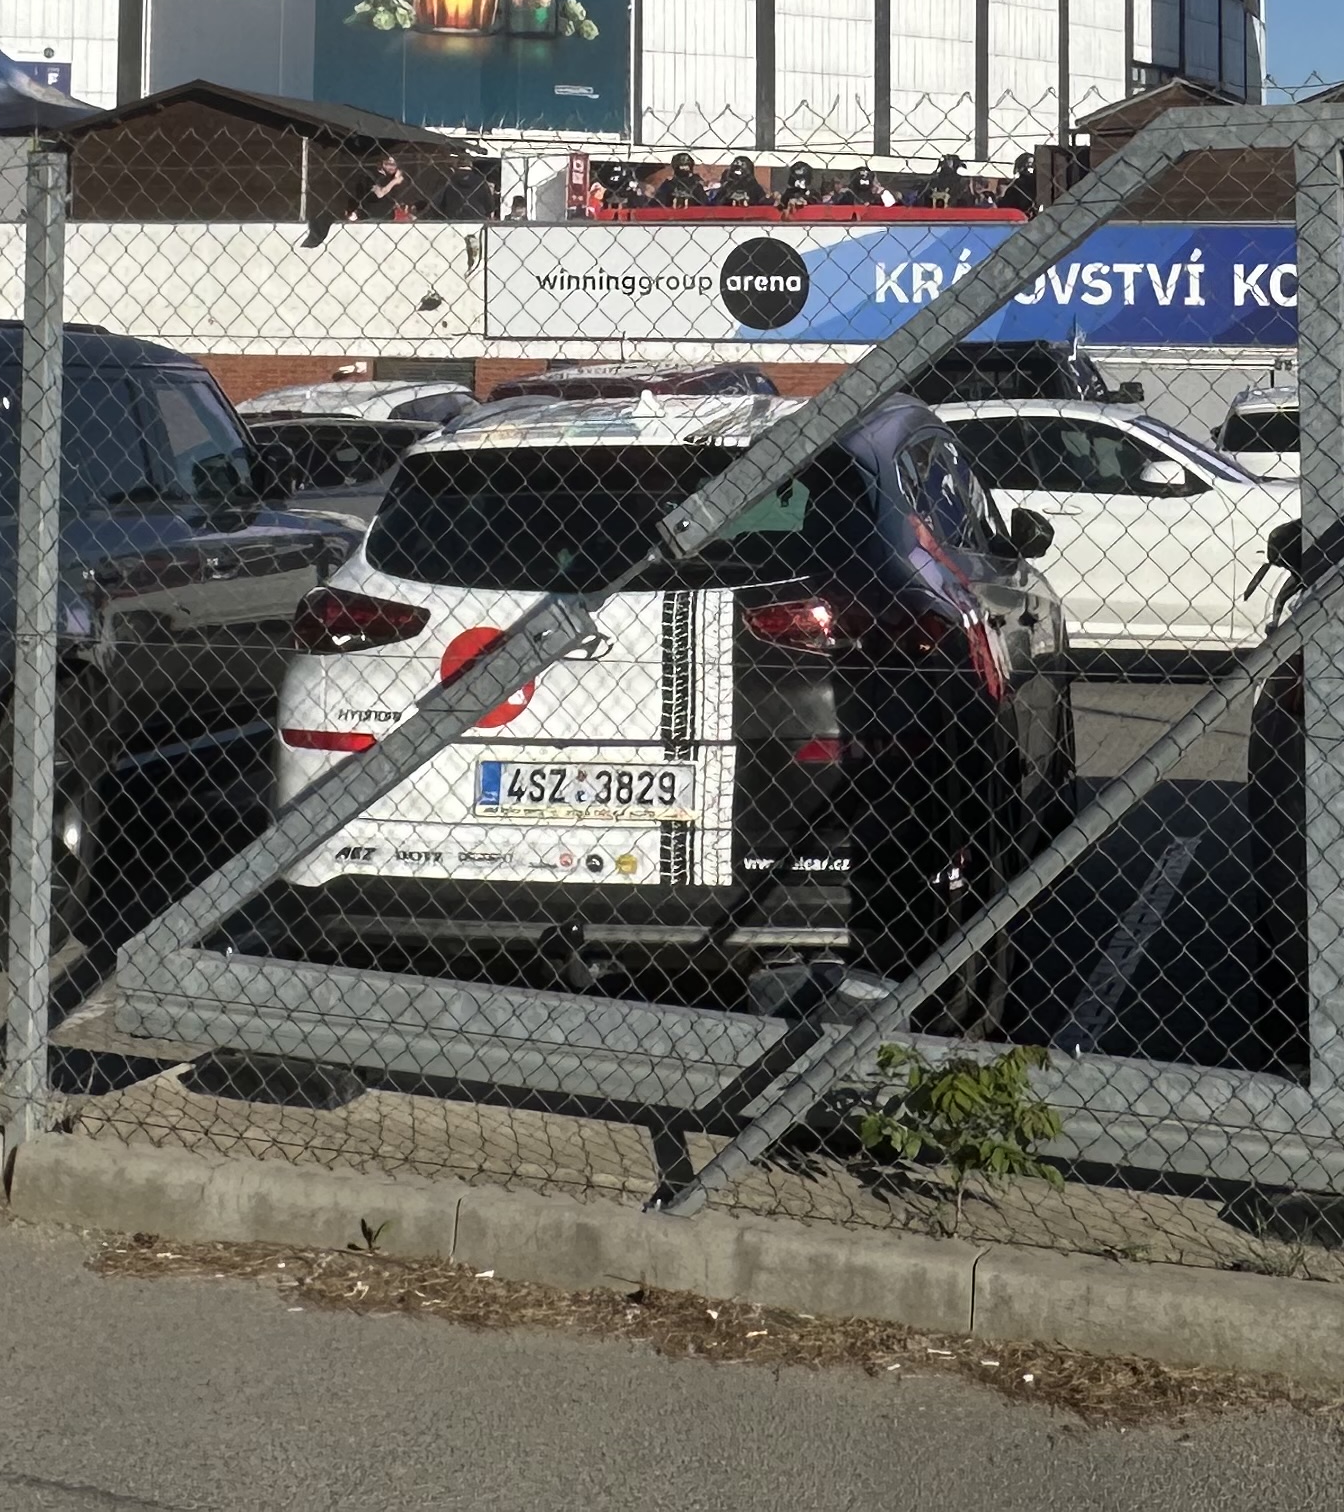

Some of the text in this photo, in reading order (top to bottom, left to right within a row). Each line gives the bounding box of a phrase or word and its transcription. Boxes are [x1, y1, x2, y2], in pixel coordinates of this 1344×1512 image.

[536, 267, 802, 295] winninggroup arena
[506, 768, 676, 805] 4SZ 3829
